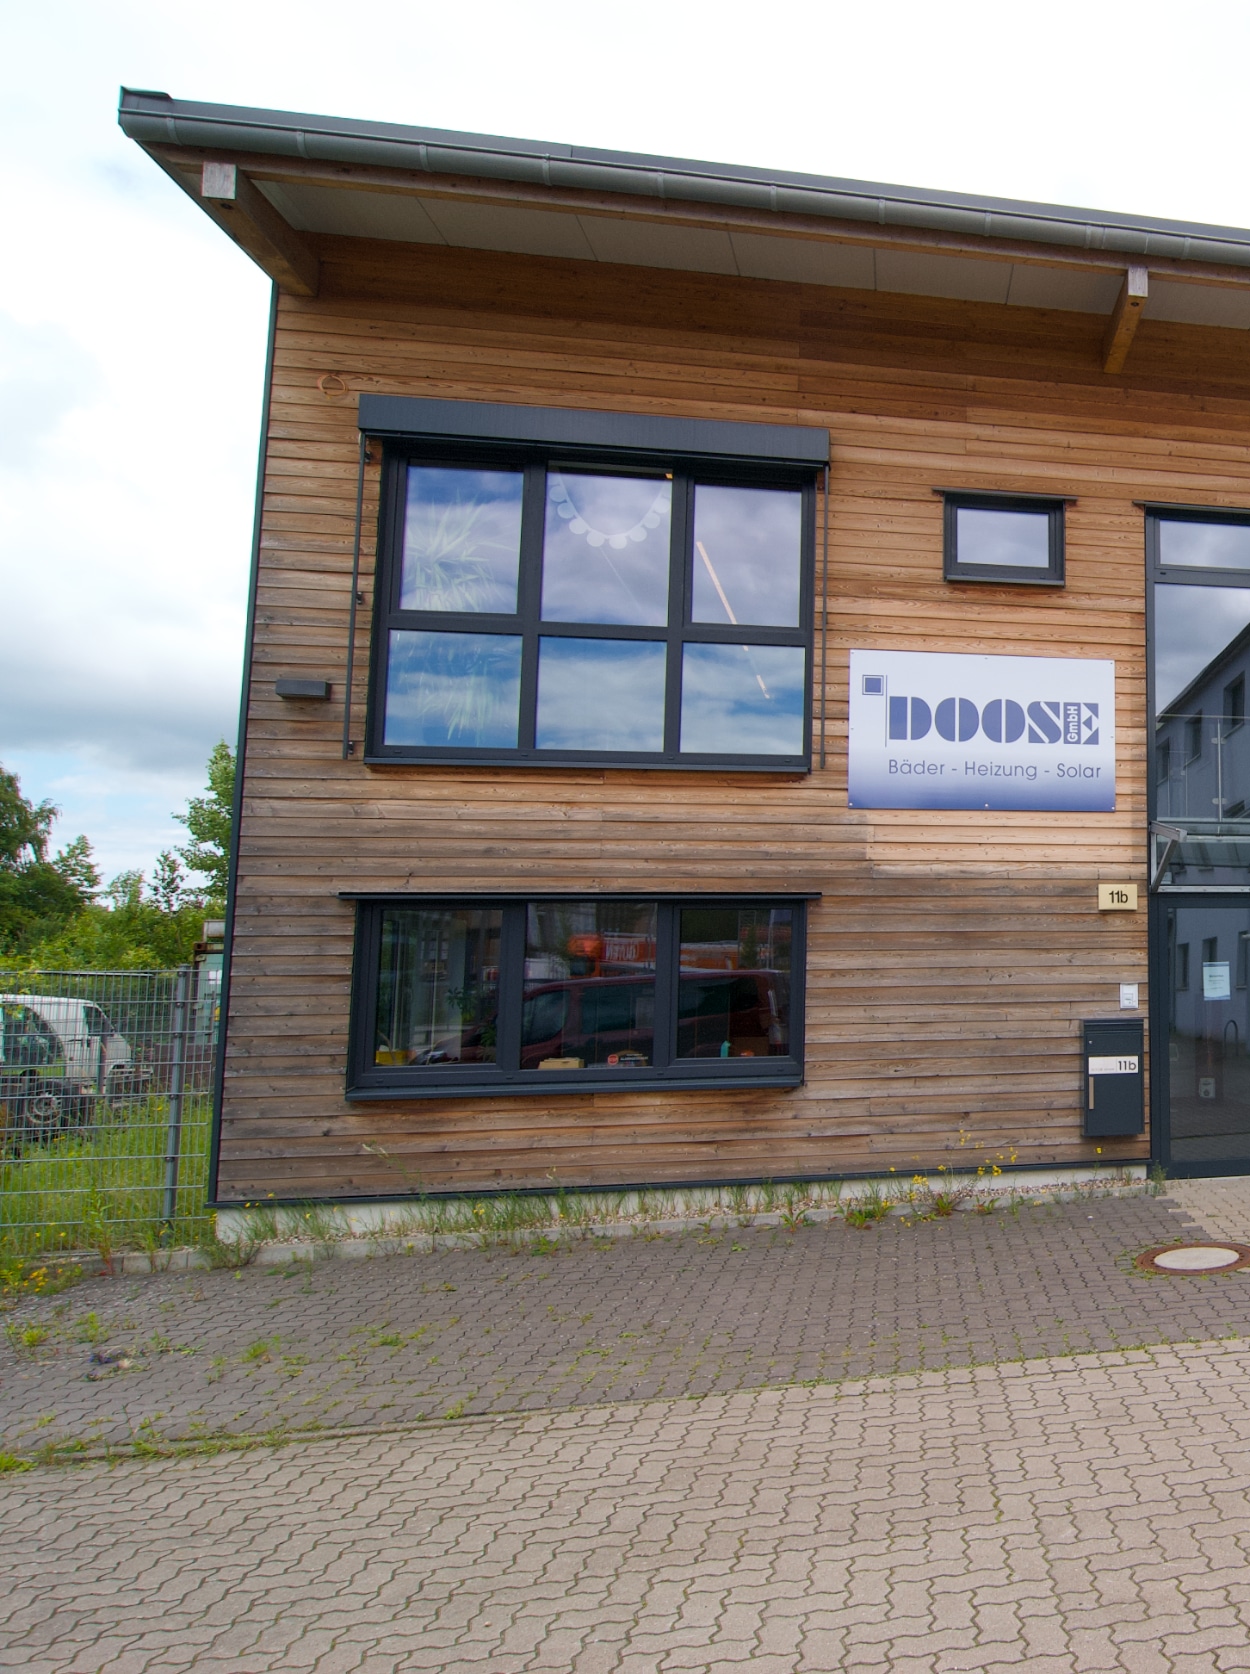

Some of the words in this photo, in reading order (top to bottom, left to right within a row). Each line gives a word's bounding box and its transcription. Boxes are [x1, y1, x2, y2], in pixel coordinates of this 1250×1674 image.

[888, 695, 1100, 746] DOOSE
[1066, 705, 1079, 742] GmbH
[888, 758, 945, 776] Bäder
[964, 760, 1038, 781] Heizung
[1056, 762, 1101, 779] Solar
[1108, 889, 1129, 904] 11b
[1118, 1060, 1137, 1072] 11b
